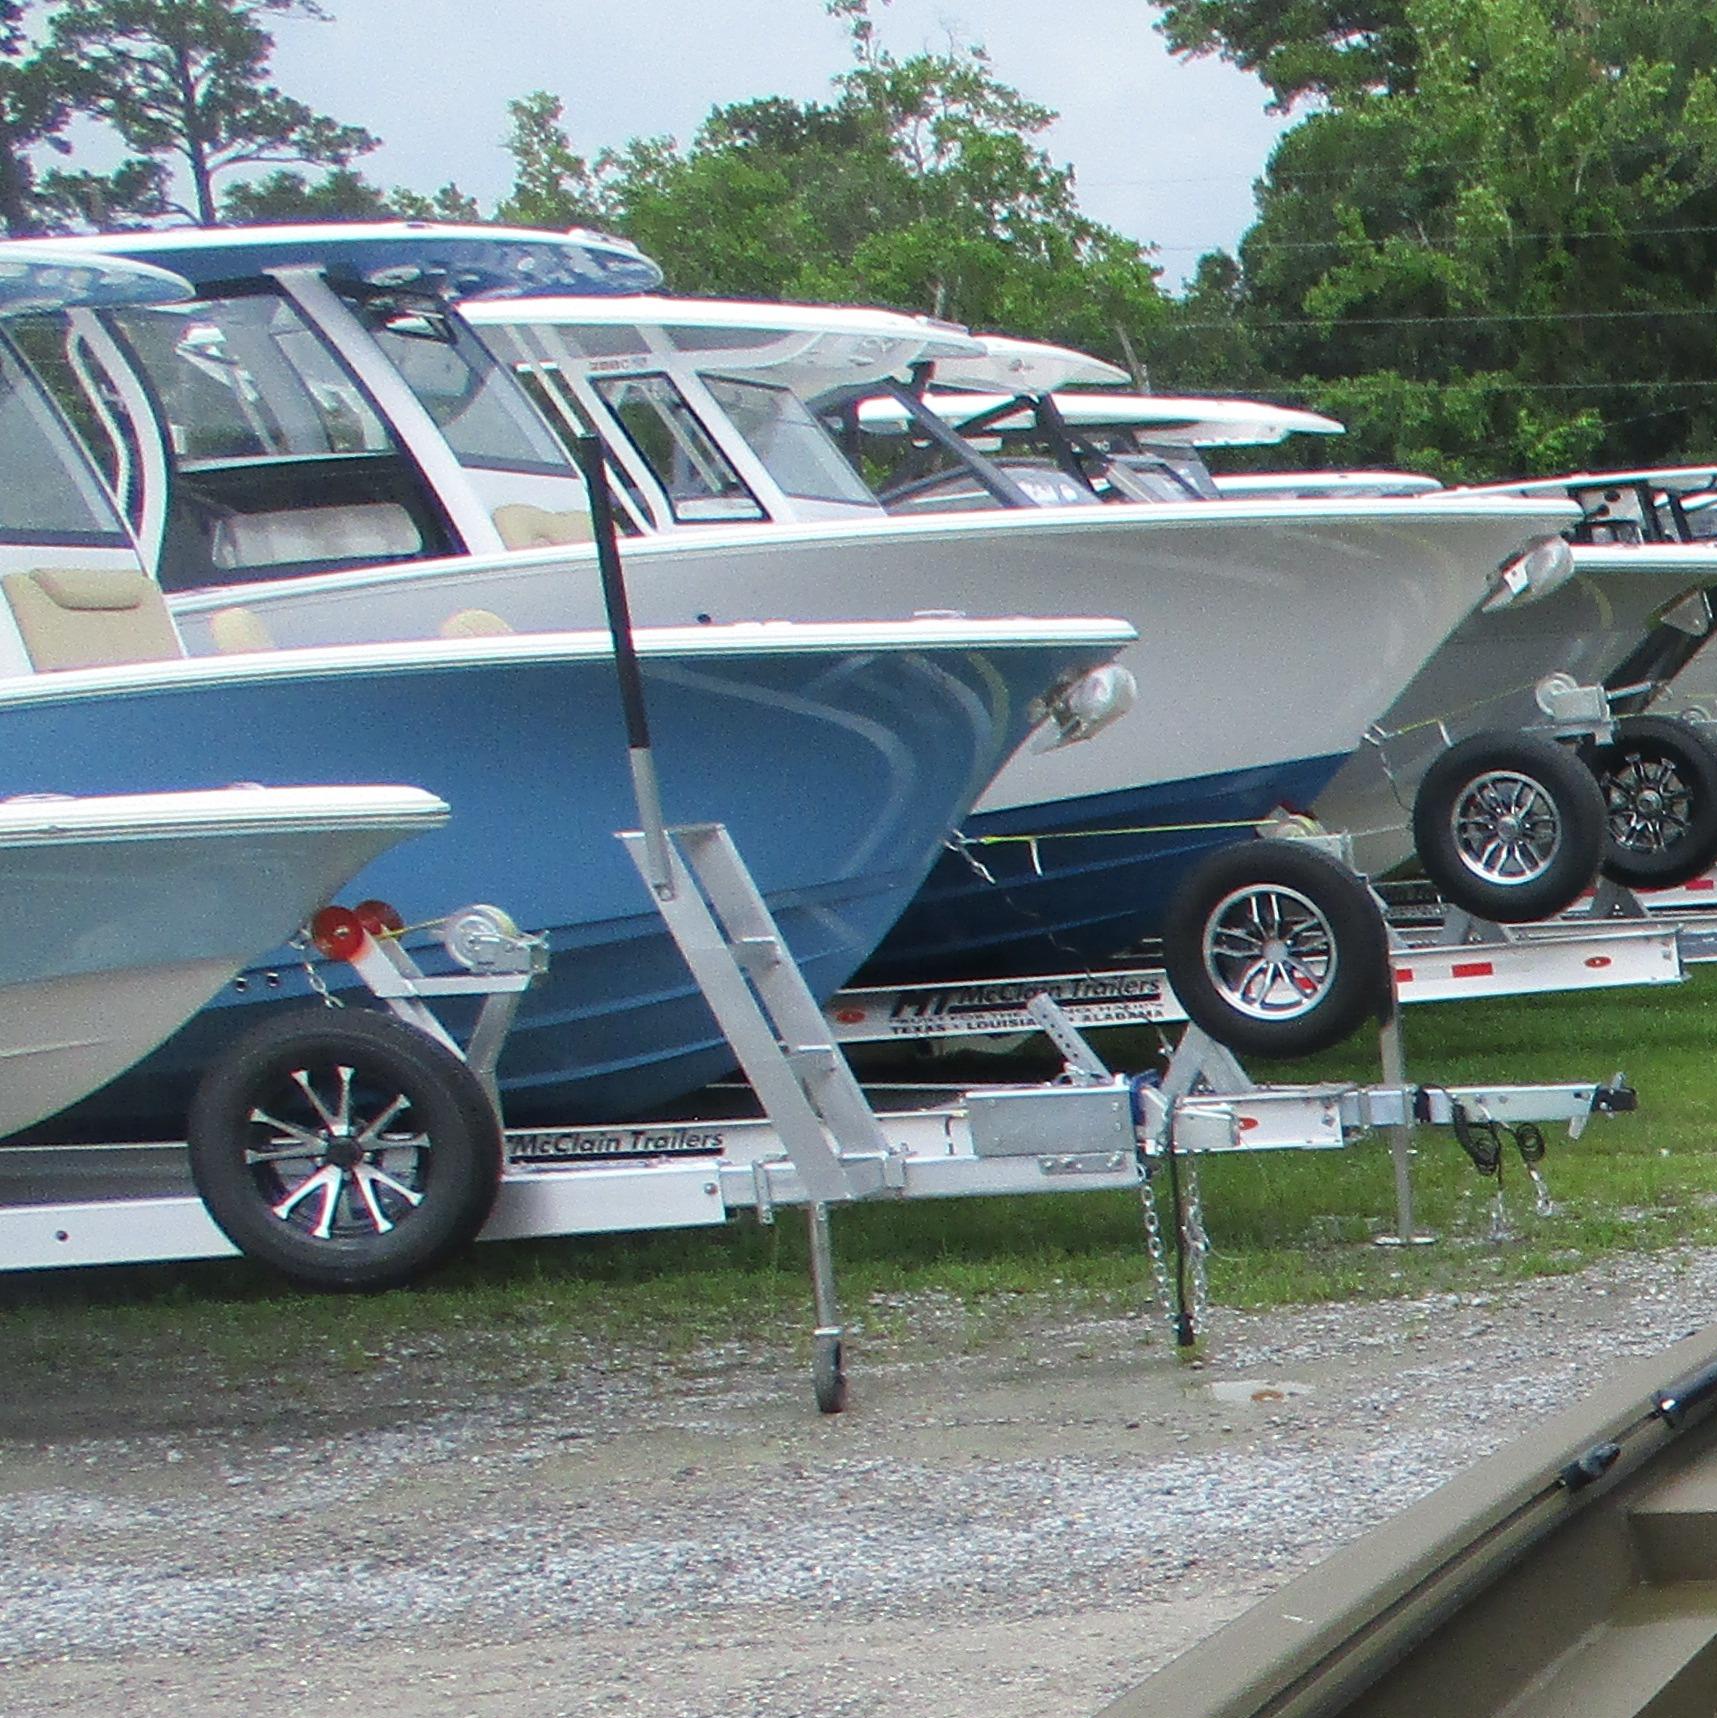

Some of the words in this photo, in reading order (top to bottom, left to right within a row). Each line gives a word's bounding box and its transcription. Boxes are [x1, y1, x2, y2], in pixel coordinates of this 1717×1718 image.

[1072, 976, 1161, 999] Trailers
[891, 1022, 946, 1036] TEXAS
[966, 1015, 1037, 1031] LOUISIA
[1083, 1008, 1164, 1022] ALABAMA
[511, 1133, 621, 1155] McClain
[631, 1129, 724, 1150] Trailers
